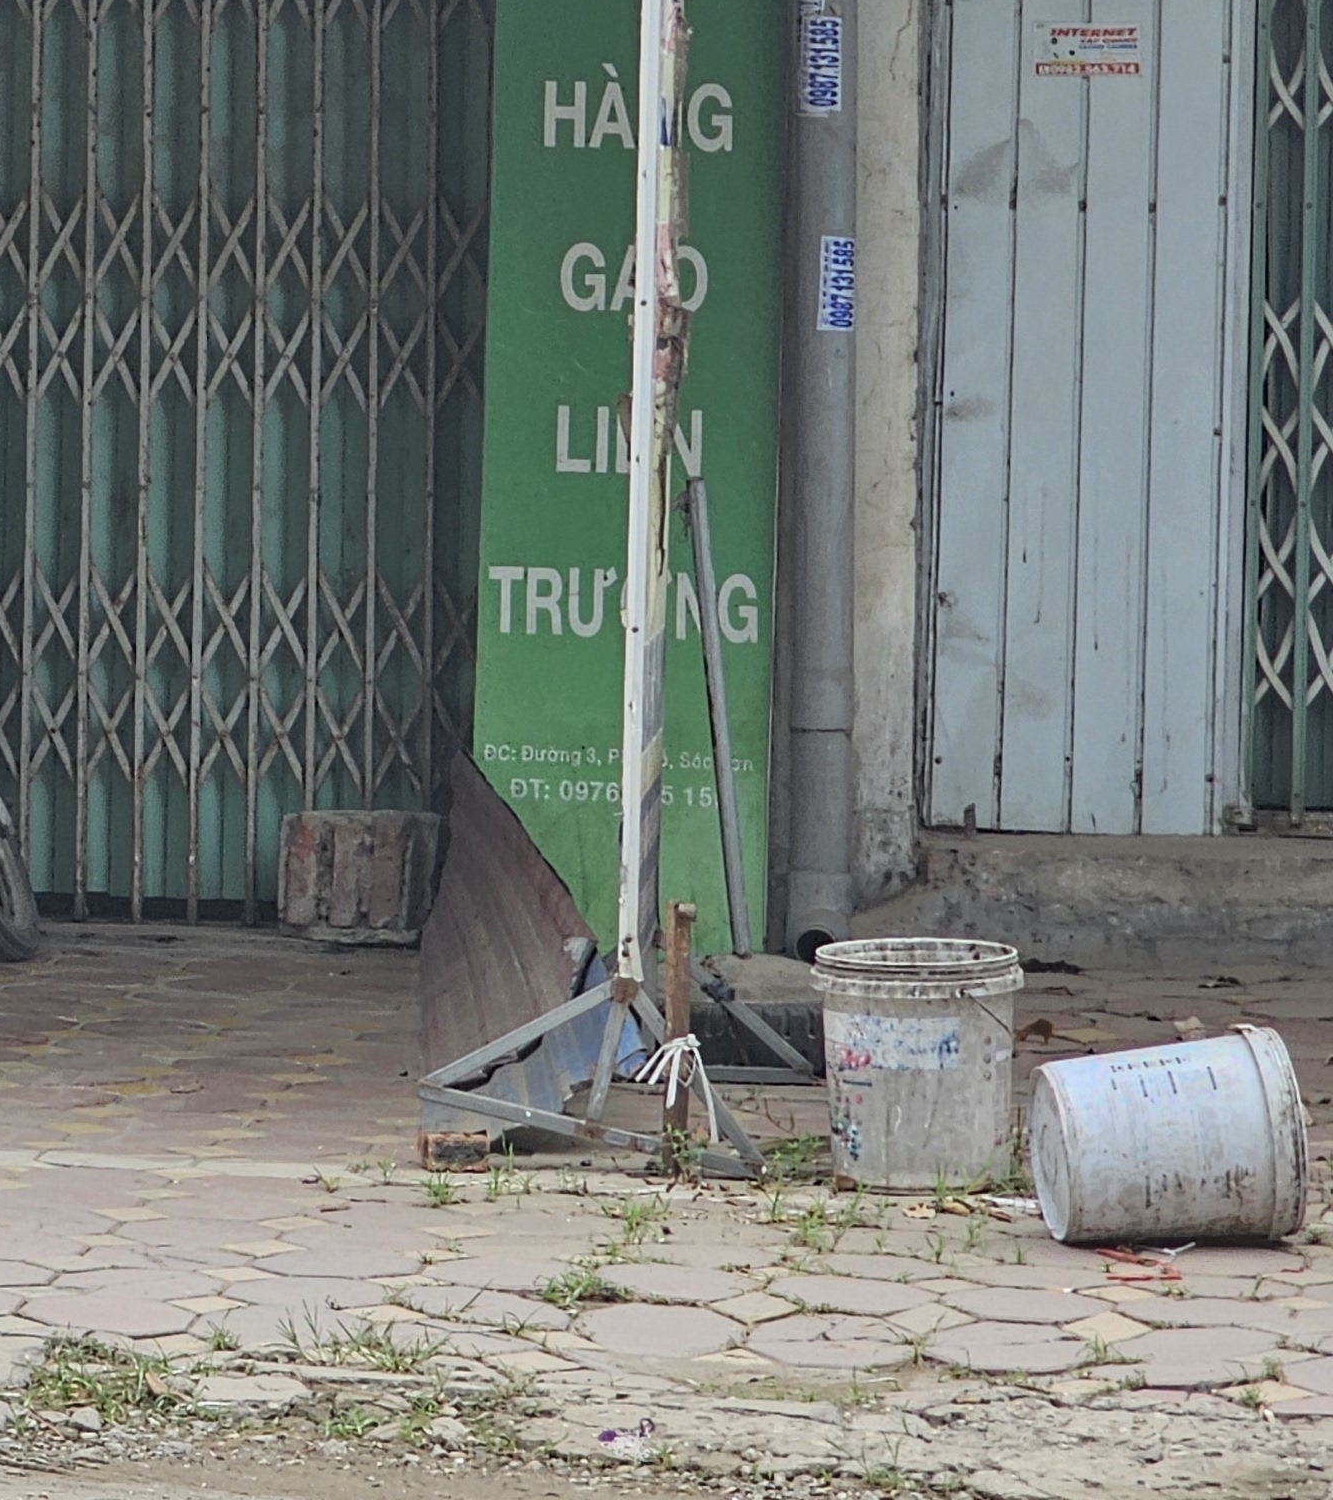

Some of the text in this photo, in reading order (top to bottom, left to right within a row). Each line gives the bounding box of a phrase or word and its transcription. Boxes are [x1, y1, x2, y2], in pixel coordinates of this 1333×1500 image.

[1050, 27, 1138, 37] INTERNET
[542, 62, 734, 152] HÀG
[488, 566, 759, 644] TRƯNG
[484, 743, 516, 762] ĐC:
[521, 744, 582, 767] Đường
[586, 747, 602, 766] 3,
[510, 778, 550, 800] ĐT:
